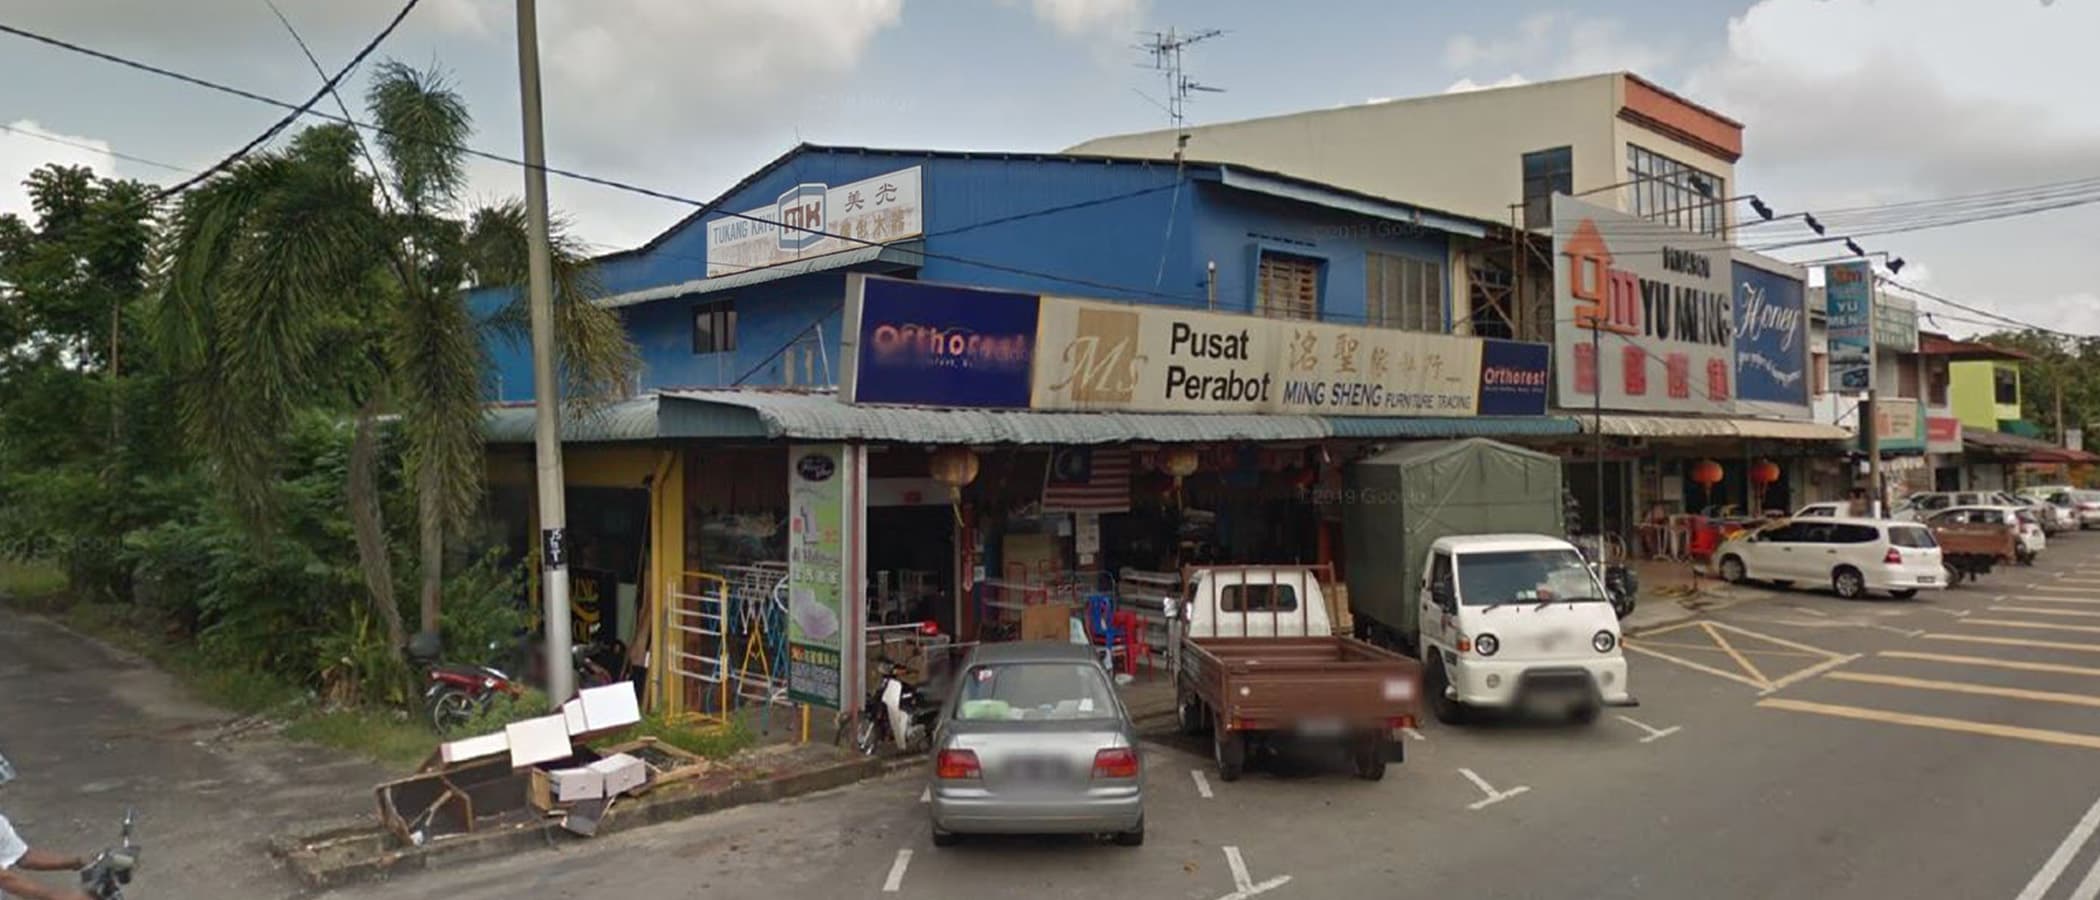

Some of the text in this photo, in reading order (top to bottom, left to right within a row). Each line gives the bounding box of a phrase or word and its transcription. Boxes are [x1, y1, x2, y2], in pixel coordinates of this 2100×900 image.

[713, 211, 776, 246] TUKANG KAYU
[1640, 278, 1731, 348] YU MENG
[1734, 281, 1801, 353] Honey
[1170, 322, 1250, 361] Pusat
[1165, 364, 1271, 402] Perabot
[1283, 380, 1326, 406] MING
[1330, 382, 1385, 408] SHENG
[1484, 367, 1546, 386] Orthorest
